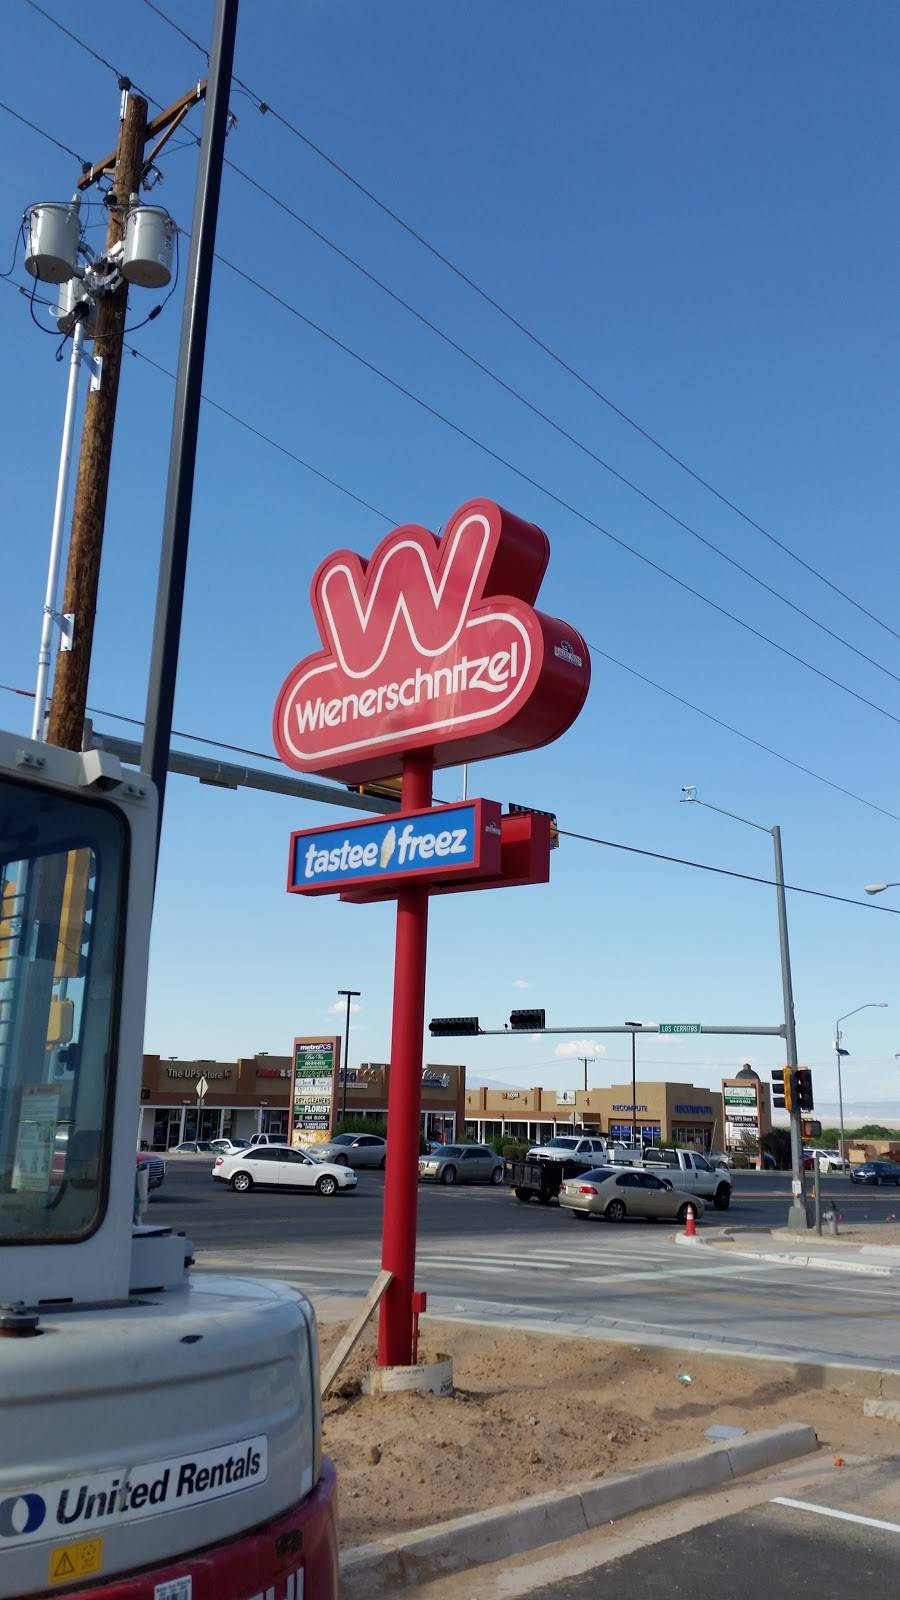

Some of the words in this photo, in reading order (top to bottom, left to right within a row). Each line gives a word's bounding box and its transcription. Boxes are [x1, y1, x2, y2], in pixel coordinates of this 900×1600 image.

[295, 642, 518, 735] Wienerschnitzel
[305, 842, 378, 879] tastee
[397, 824, 468, 866] freez
[300, 1043, 332, 1051] metroPCS
[168, 1068, 183, 1078] The
[184, 1068, 200, 1079] UPS
[202, 1069, 222, 1079] Store
[304, 1105, 331, 1113] FLORIST
[612, 1104, 648, 1112] RECOMPUTE
[56, 1468, 170, 1525] United
[176, 1446, 261, 1498] Rentals
